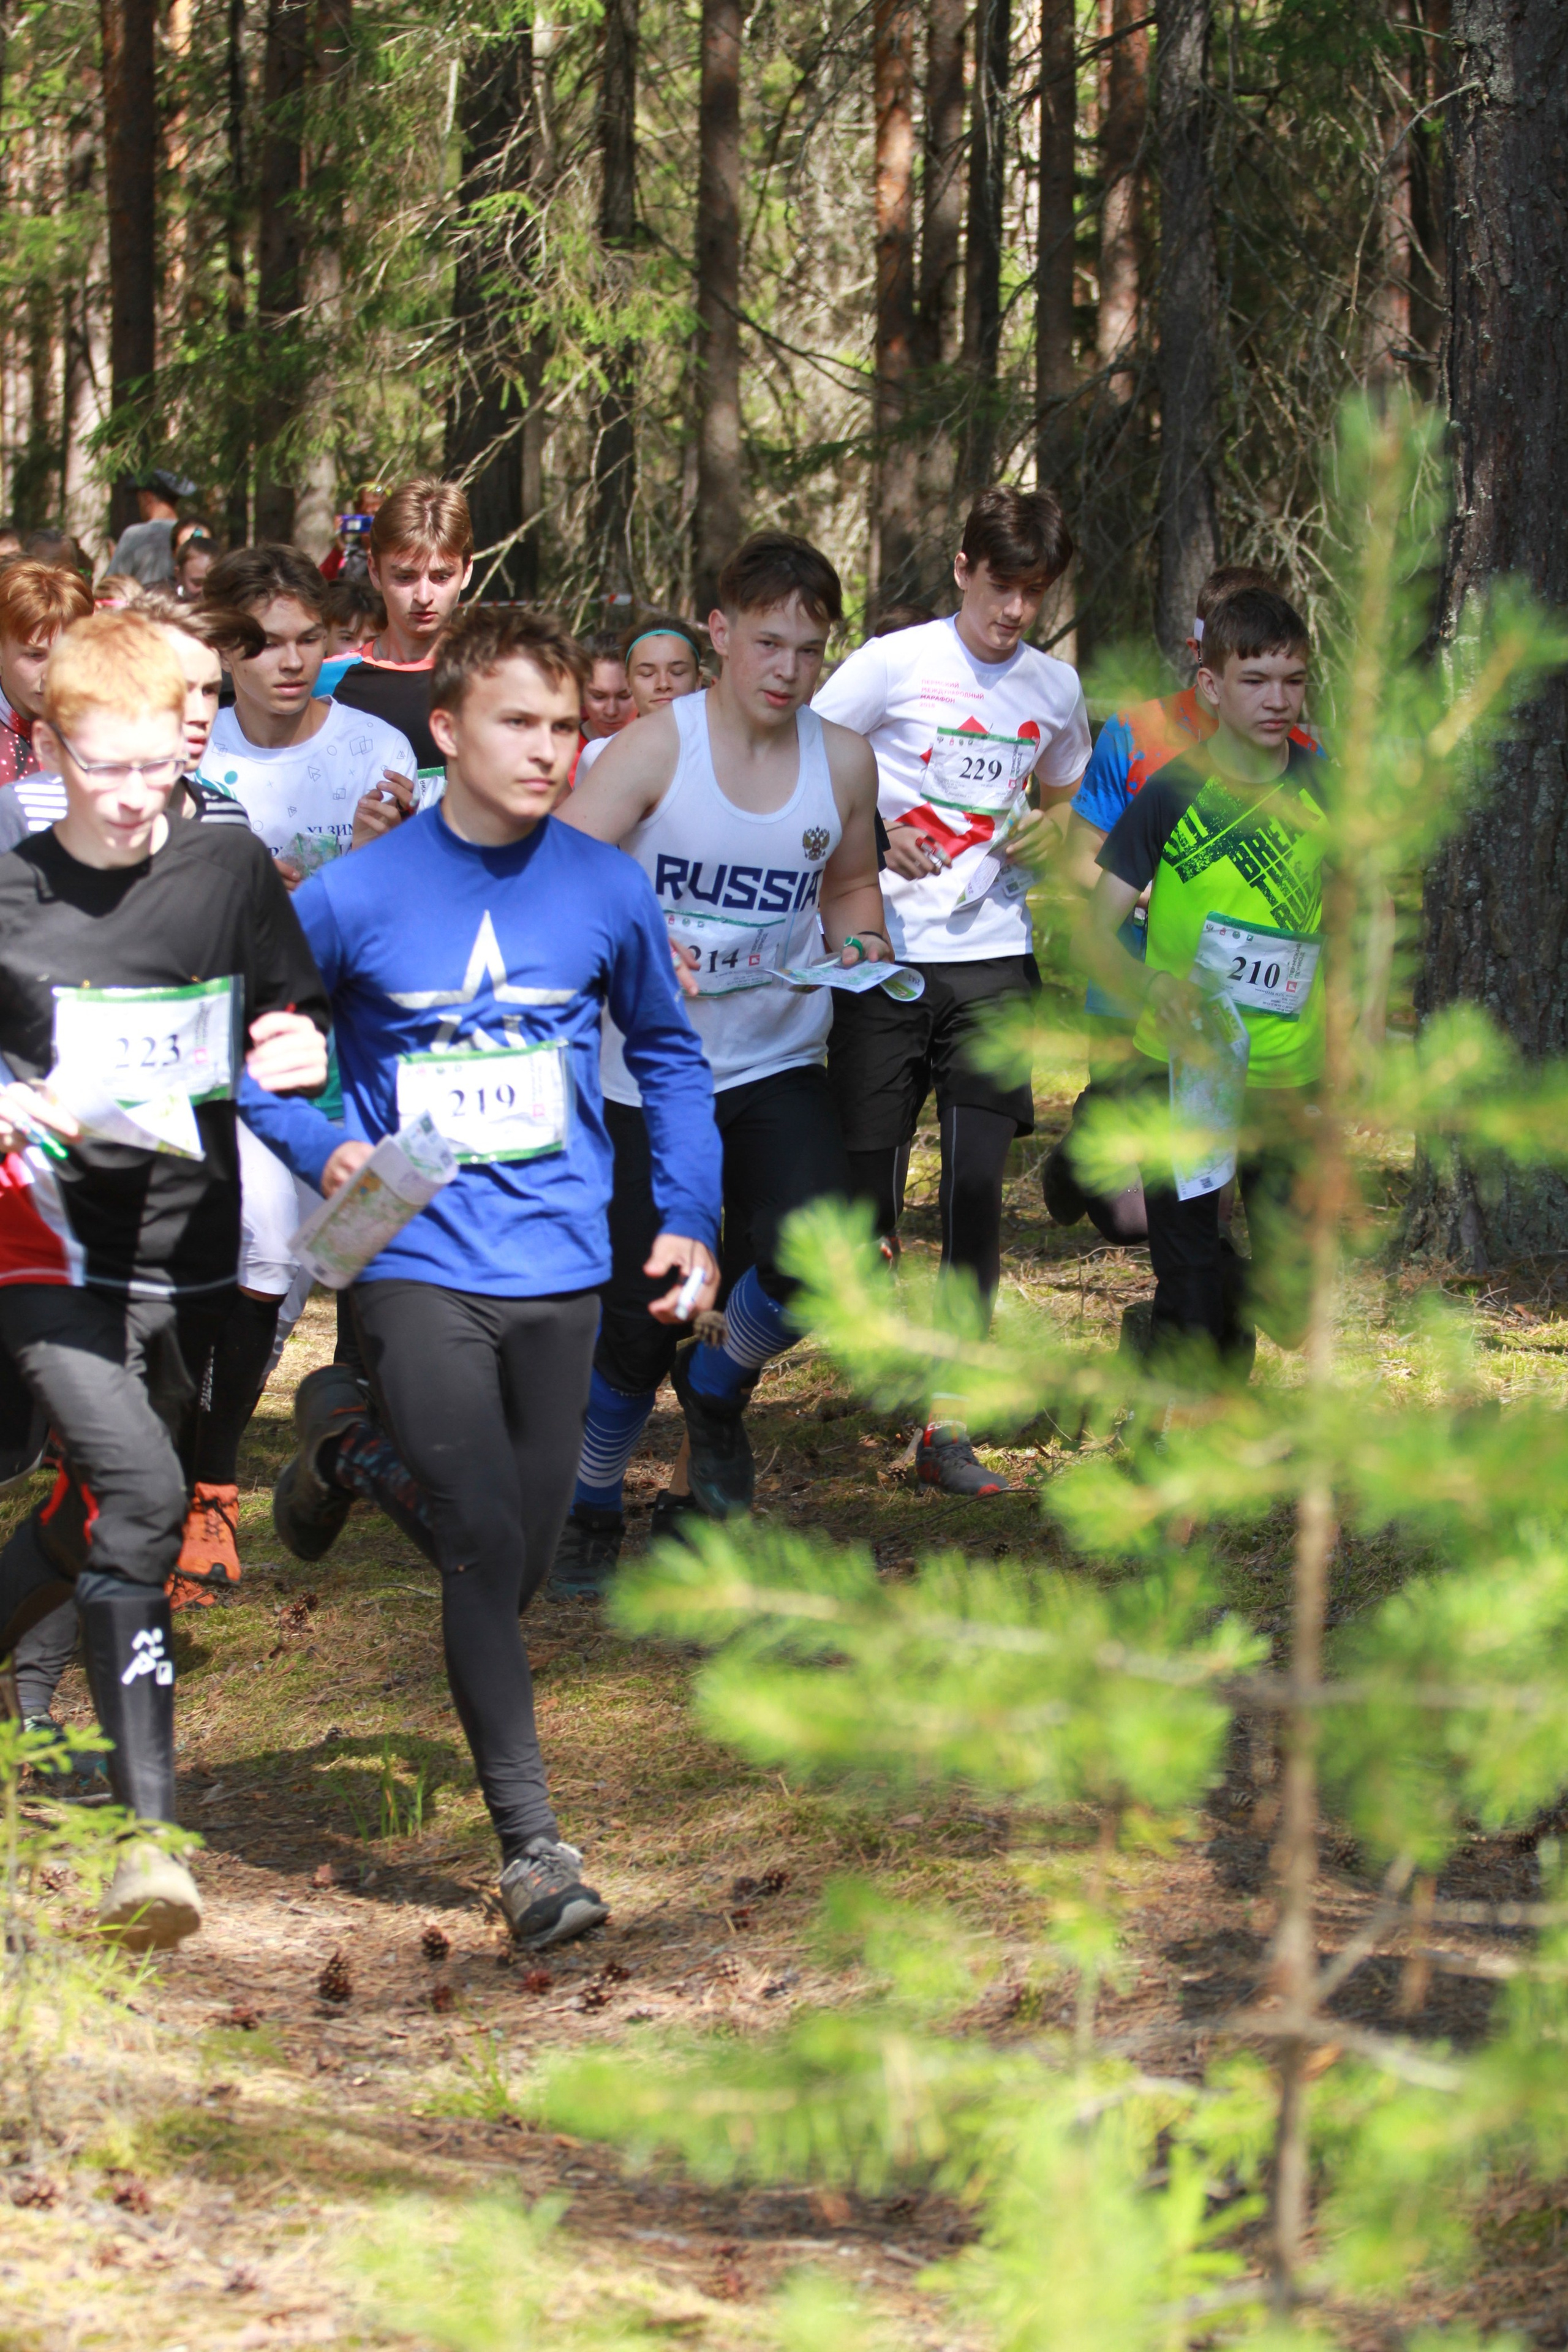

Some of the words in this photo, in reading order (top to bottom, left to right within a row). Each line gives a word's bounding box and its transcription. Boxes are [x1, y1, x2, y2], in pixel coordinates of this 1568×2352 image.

[959, 757, 1002, 782] 229
[655, 853, 824, 913] RUSSIA
[1227, 957, 1280, 989] 210
[115, 1034, 179, 1069] 223
[449, 1084, 515, 1117] 219
